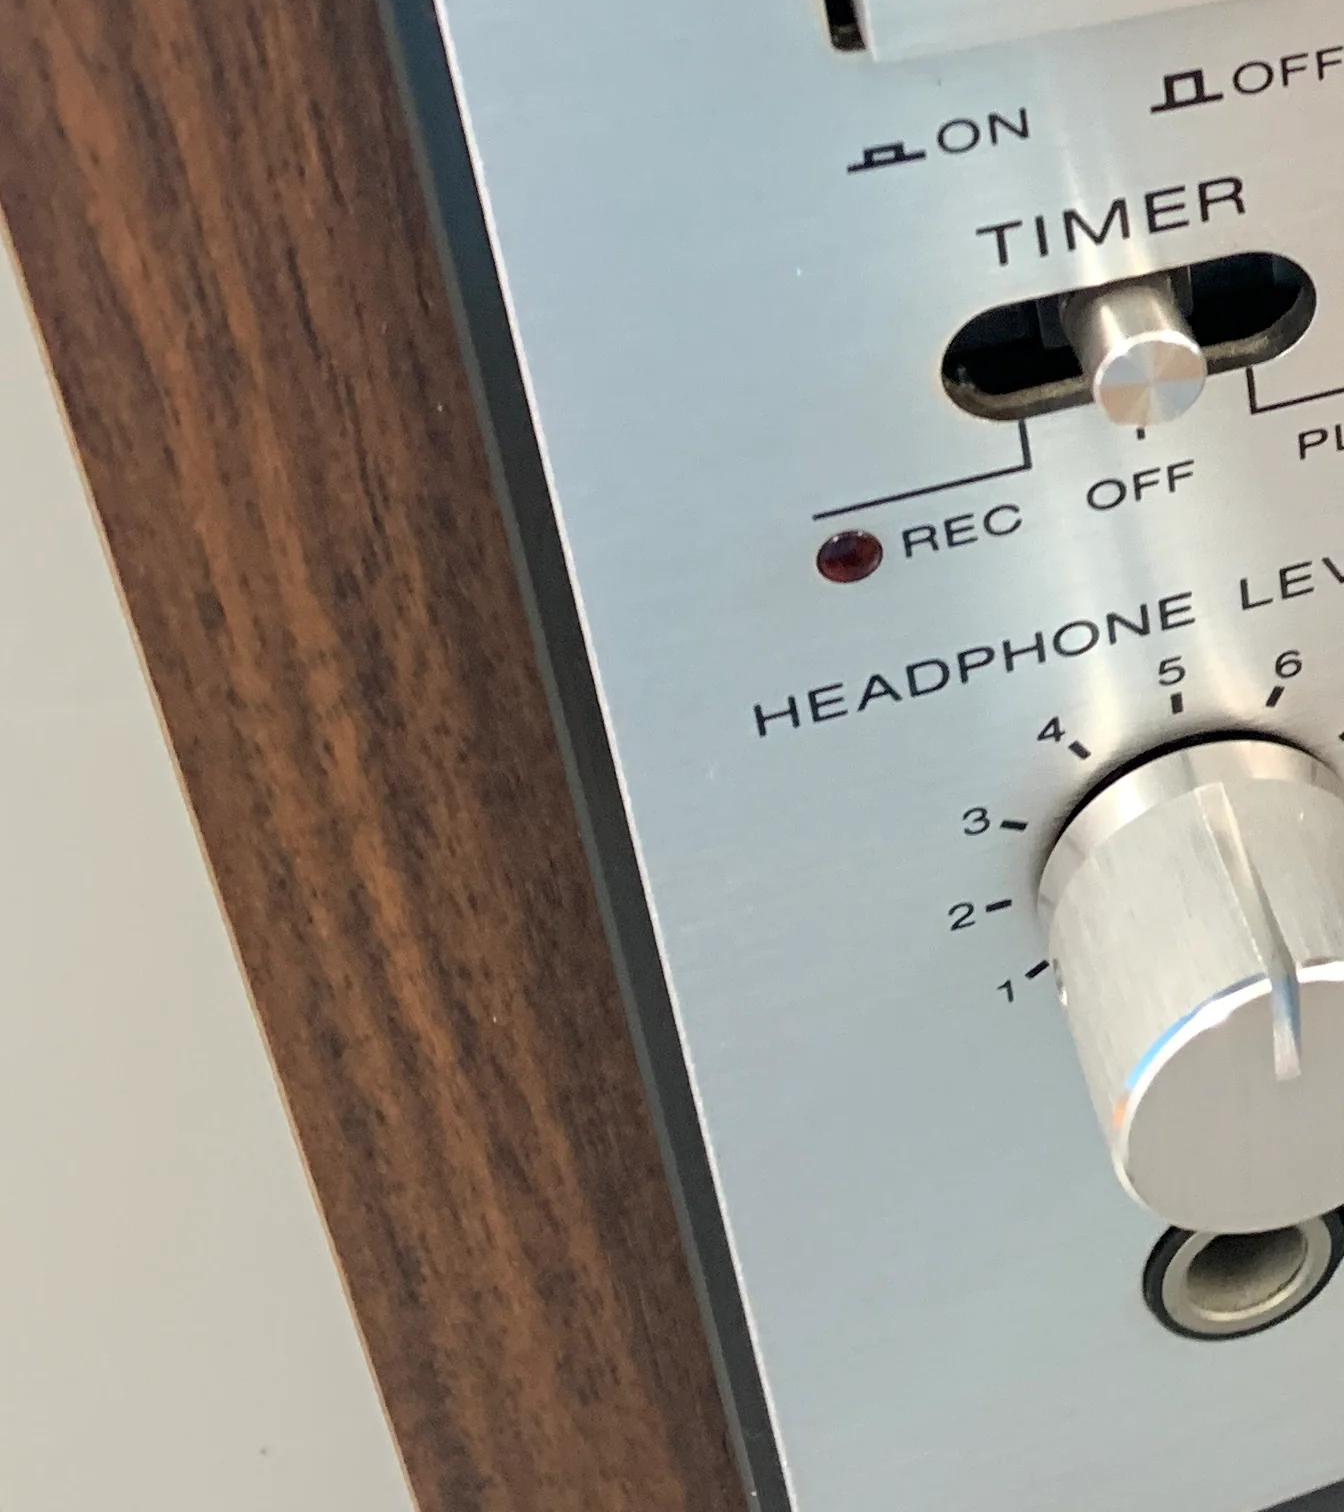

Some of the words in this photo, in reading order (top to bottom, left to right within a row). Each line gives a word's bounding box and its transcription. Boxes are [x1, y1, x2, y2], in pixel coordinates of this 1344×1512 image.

[1231, 46, 1344, 95] OFF
[936, 107, 1030, 155] ON
[976, 175, 1247, 268] TIMER
[1086, 459, 1197, 511] OFF
[901, 503, 1024, 559] REC
[753, 590, 1197, 737] HEADPHONE
[1158, 657, 1186, 686] 5
[1274, 649, 1303, 679] 6
[1036, 715, 1066, 745] 4
[962, 808, 991, 835] 3
[947, 902, 976, 932] 2
